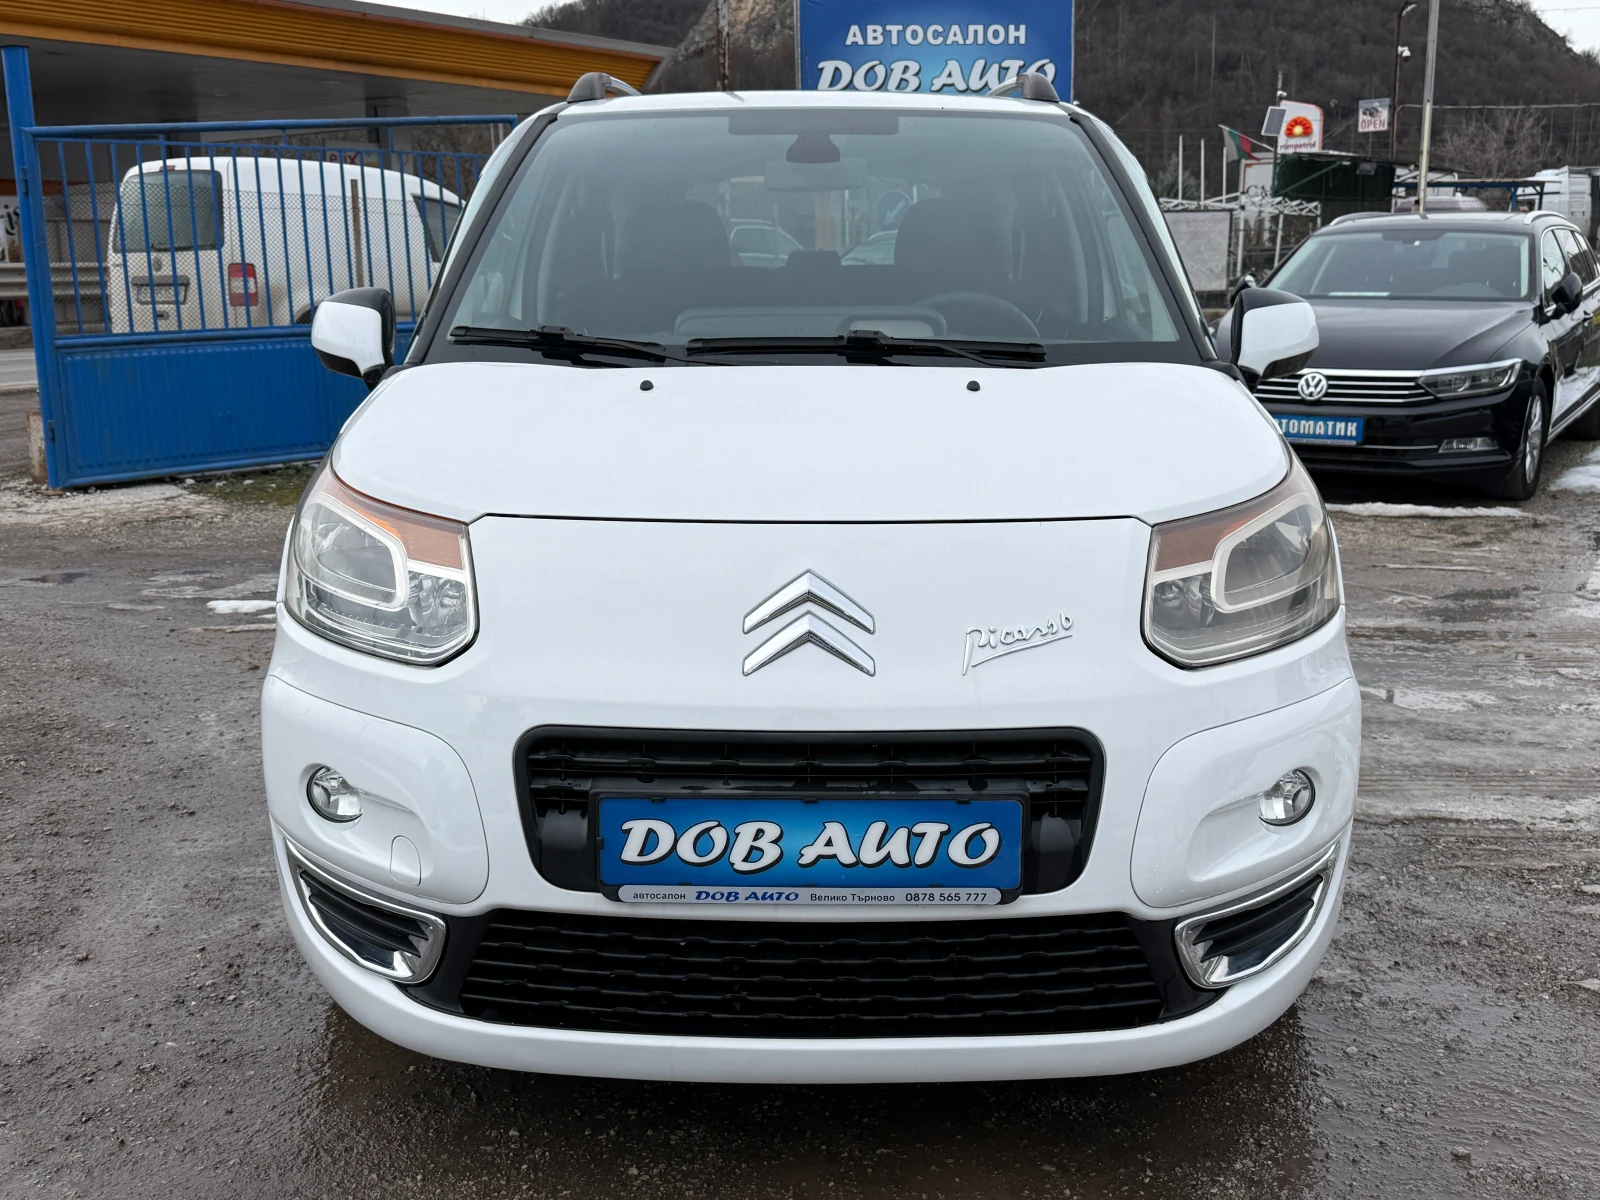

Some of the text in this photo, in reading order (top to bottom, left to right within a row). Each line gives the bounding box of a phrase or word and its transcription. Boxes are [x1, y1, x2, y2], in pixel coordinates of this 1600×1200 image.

[845, 24, 1027, 46] АВТОСАЛОН
[817, 58, 921, 93] DOB
[1360, 118, 1386, 131] OPEN
[962, 612, 1073, 676] Picasso
[621, 819, 1001, 875] DOB AUTO
[633, 890, 987, 904] автосалон DOB AUTO Велико Търново 0878 565 777
